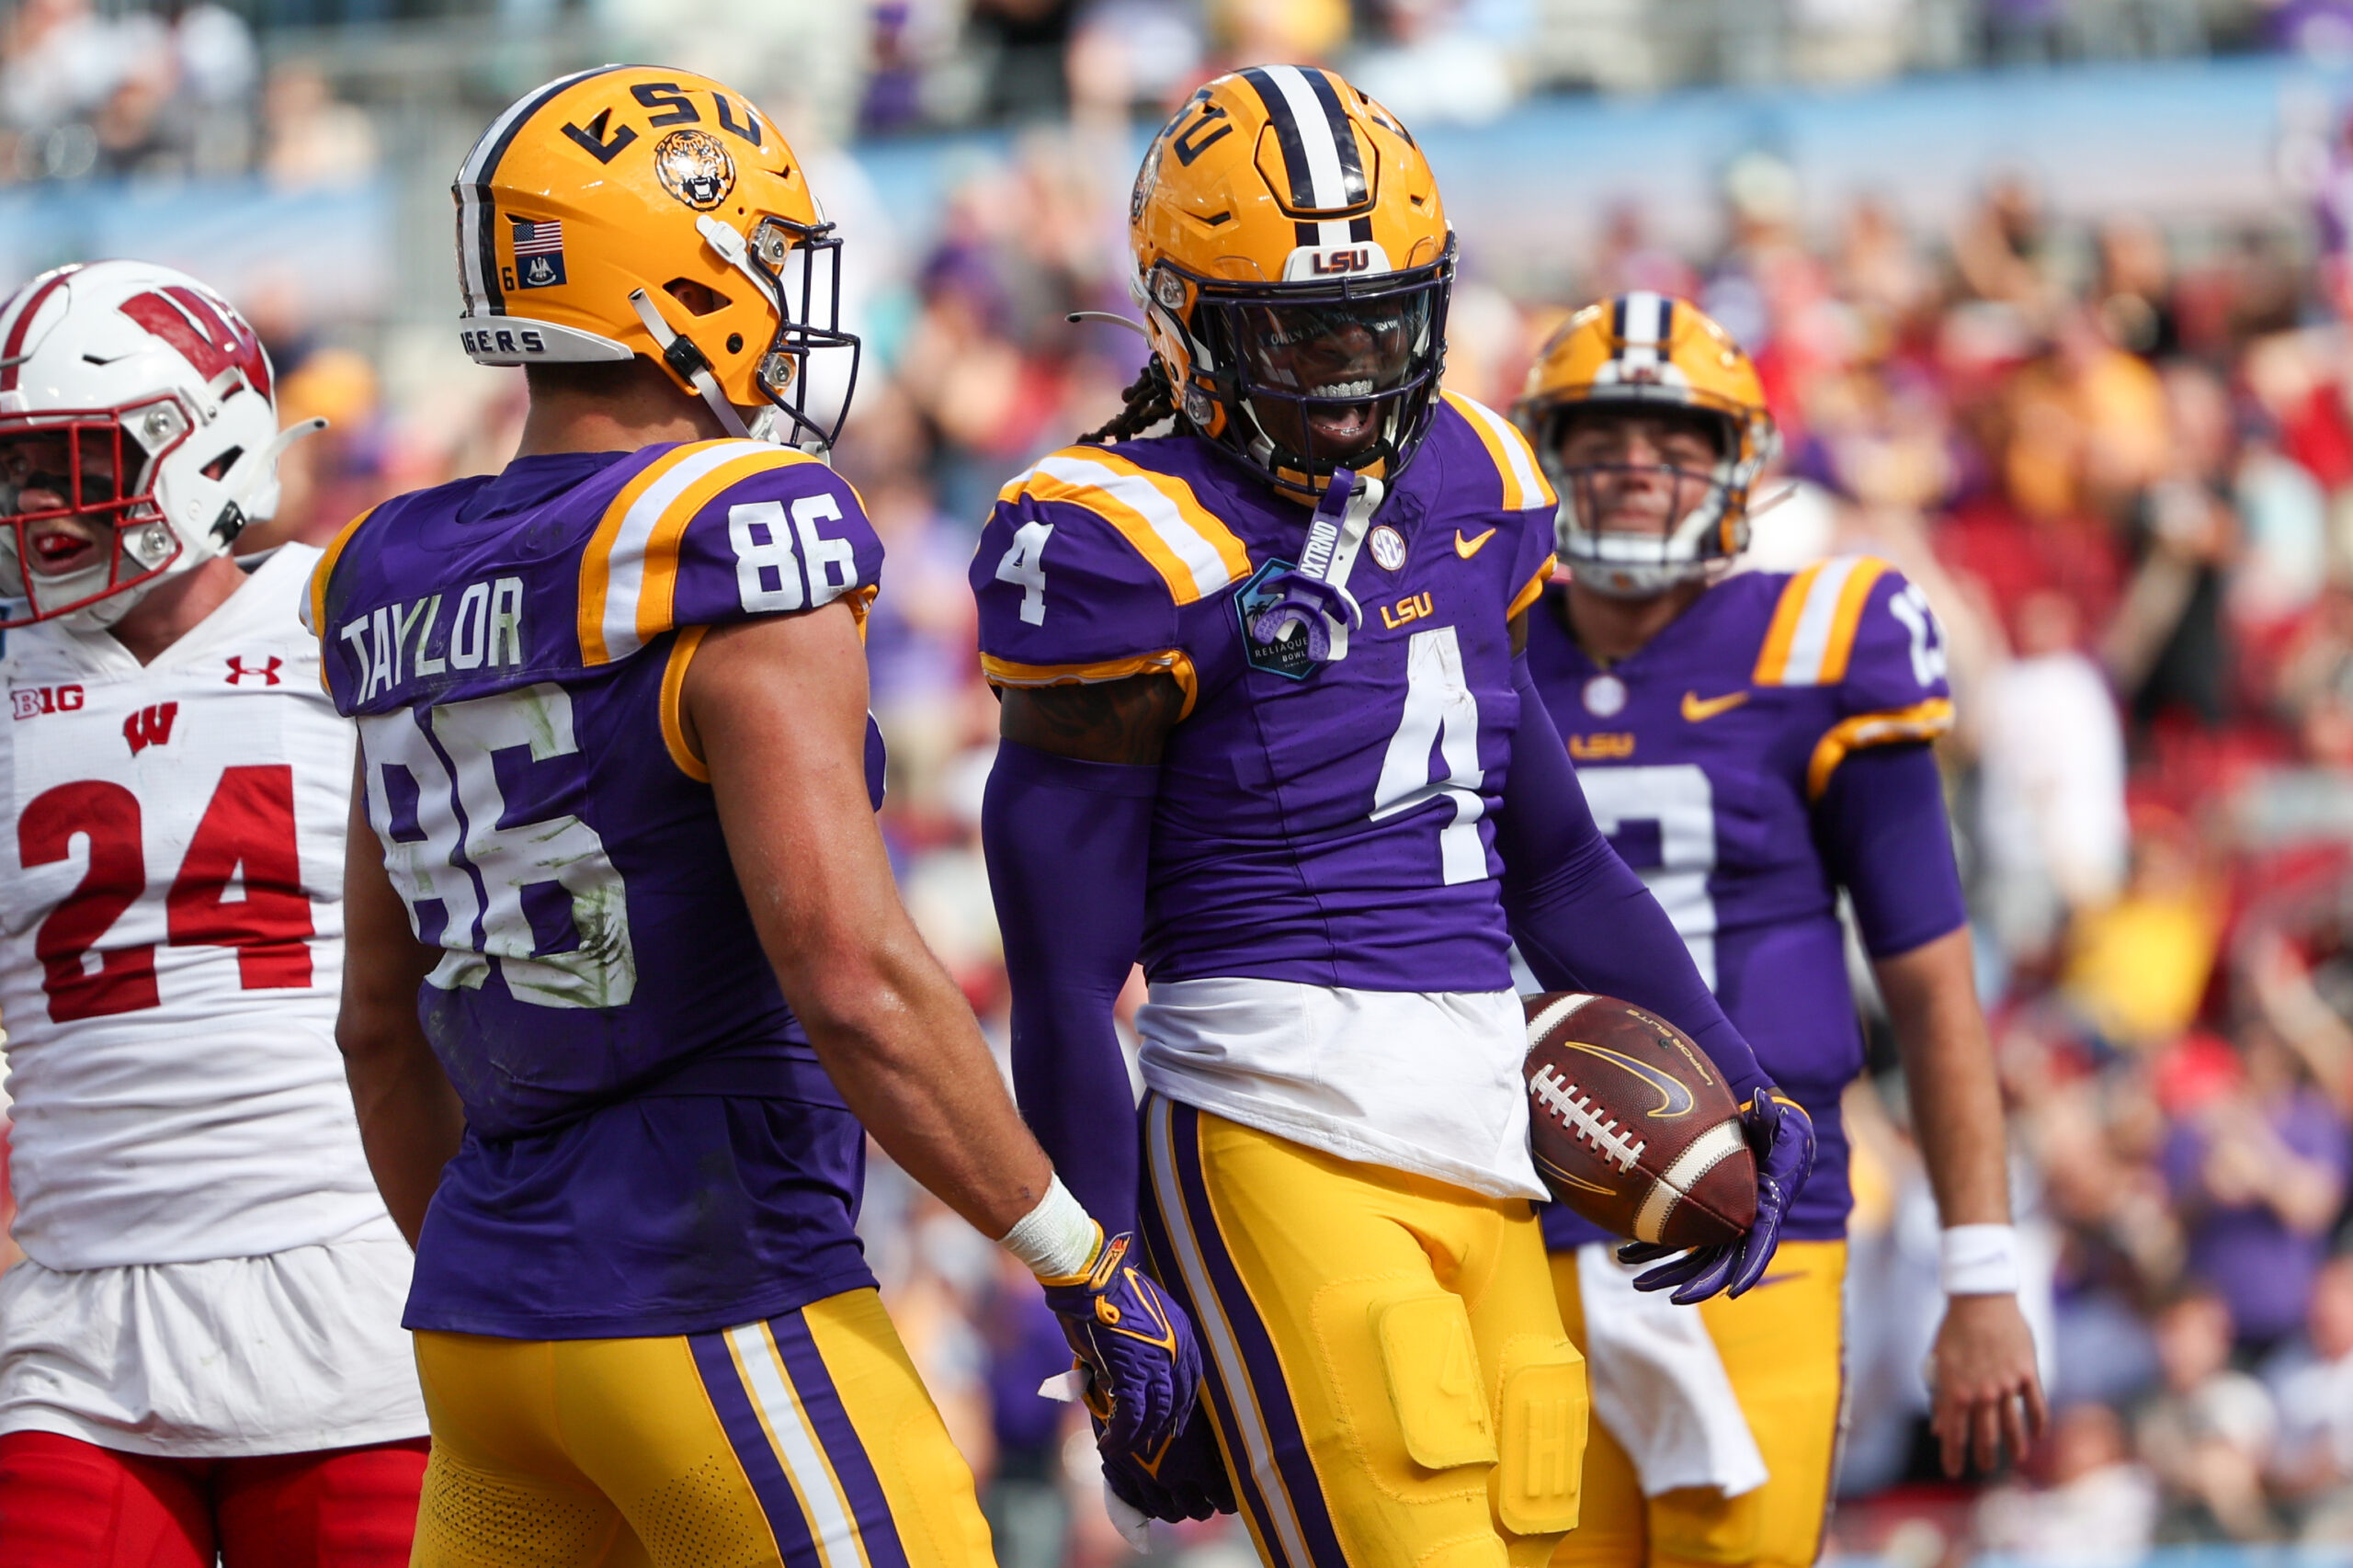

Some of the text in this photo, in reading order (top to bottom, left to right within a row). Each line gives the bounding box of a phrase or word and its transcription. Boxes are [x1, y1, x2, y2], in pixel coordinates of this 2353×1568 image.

[561, 83, 762, 165] LSU
[502, 267, 516, 291] 6
[1313, 249, 1370, 274] LSU
[460, 331, 545, 356] IGERS
[728, 493, 858, 614] 86
[995, 520, 1055, 627] 4
[1301, 520, 1338, 579] NXTRND
[1372, 527, 1404, 569] SEC
[1381, 591, 1434, 630] LSU
[341, 576, 524, 706] TAYLOR
[1255, 637, 1309, 657] RELIAQUE
[123, 701, 178, 757] W
[1370, 625, 1489, 885] 4
[1569, 733, 1635, 759] LSU
[357, 681, 638, 1009] 86
[17, 765, 315, 1024] 24
[1625, 1009, 1673, 1038] ELITE
